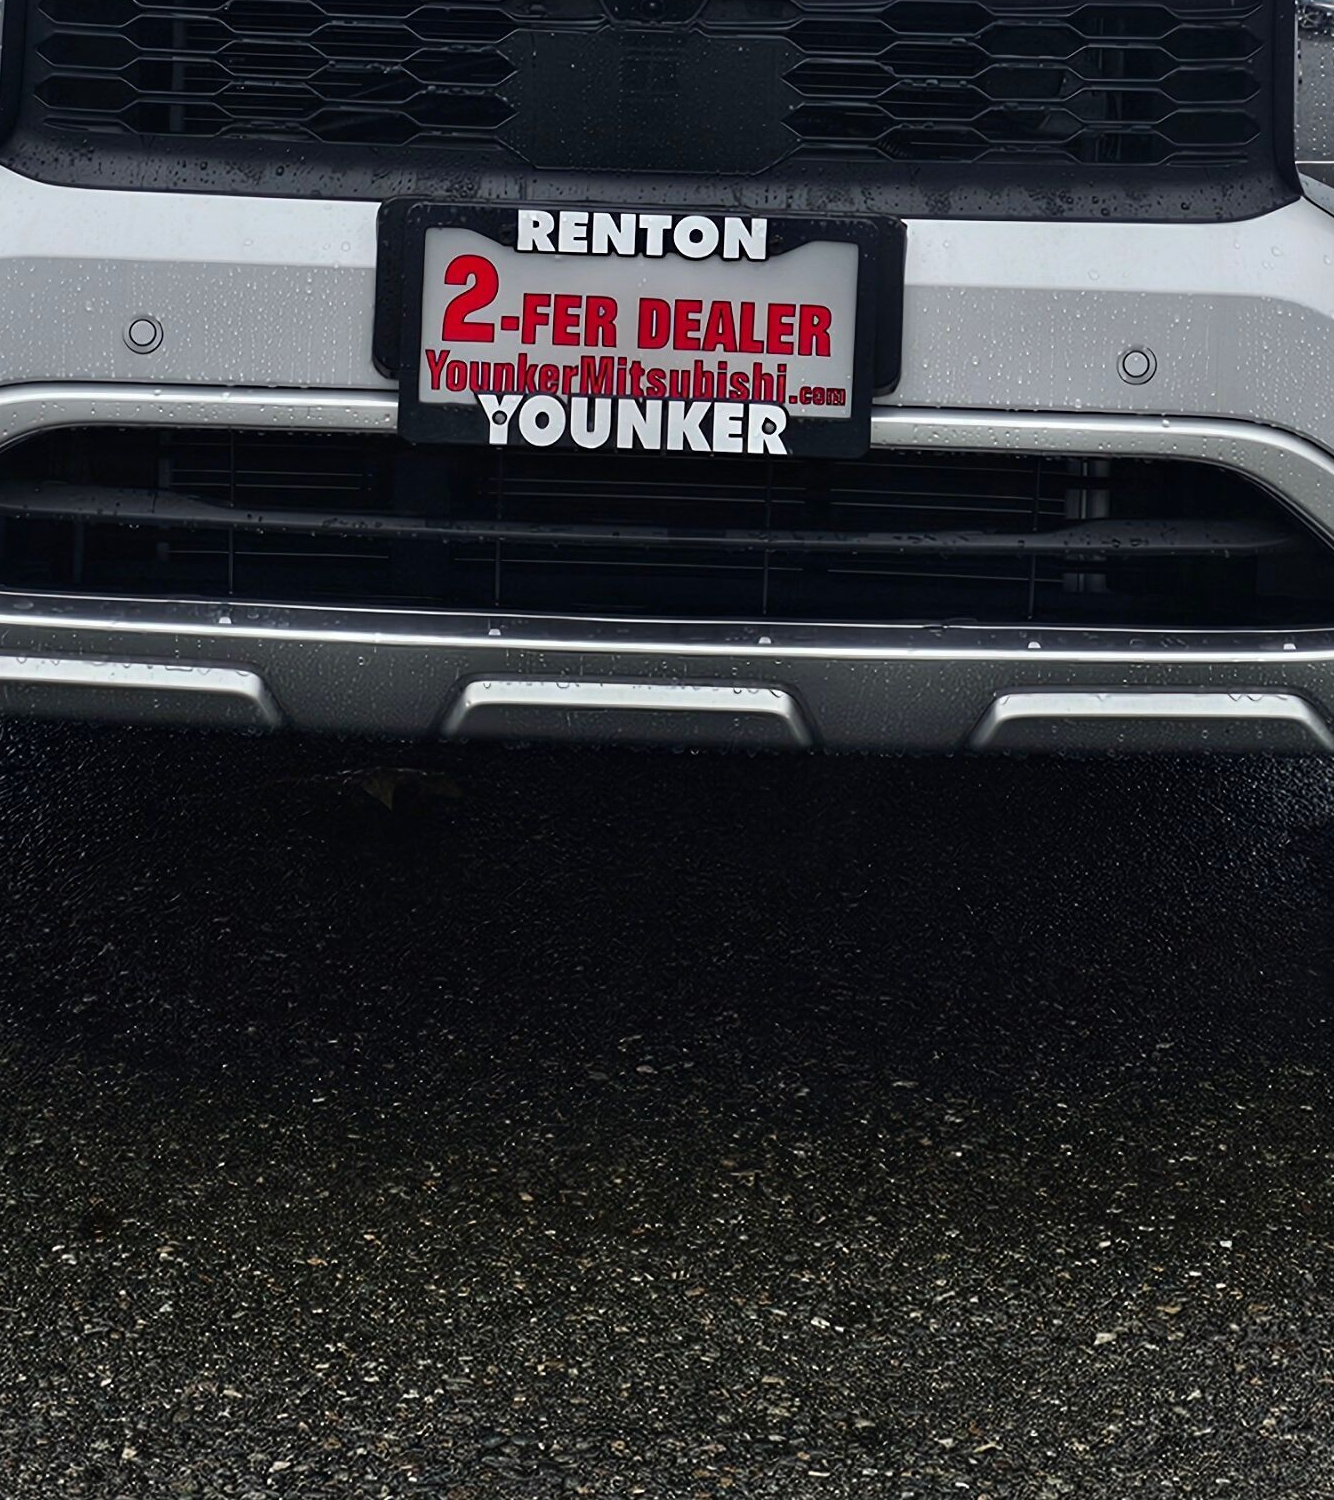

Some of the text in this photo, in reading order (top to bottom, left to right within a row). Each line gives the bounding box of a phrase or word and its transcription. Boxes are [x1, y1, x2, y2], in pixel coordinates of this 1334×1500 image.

[516, 209, 768, 260] RENTON
[441, 254, 833, 358] 2-FER DEALER
[425, 348, 847, 407] YounkerMitsubishi.com
[476, 393, 788, 456] YOUNKER
